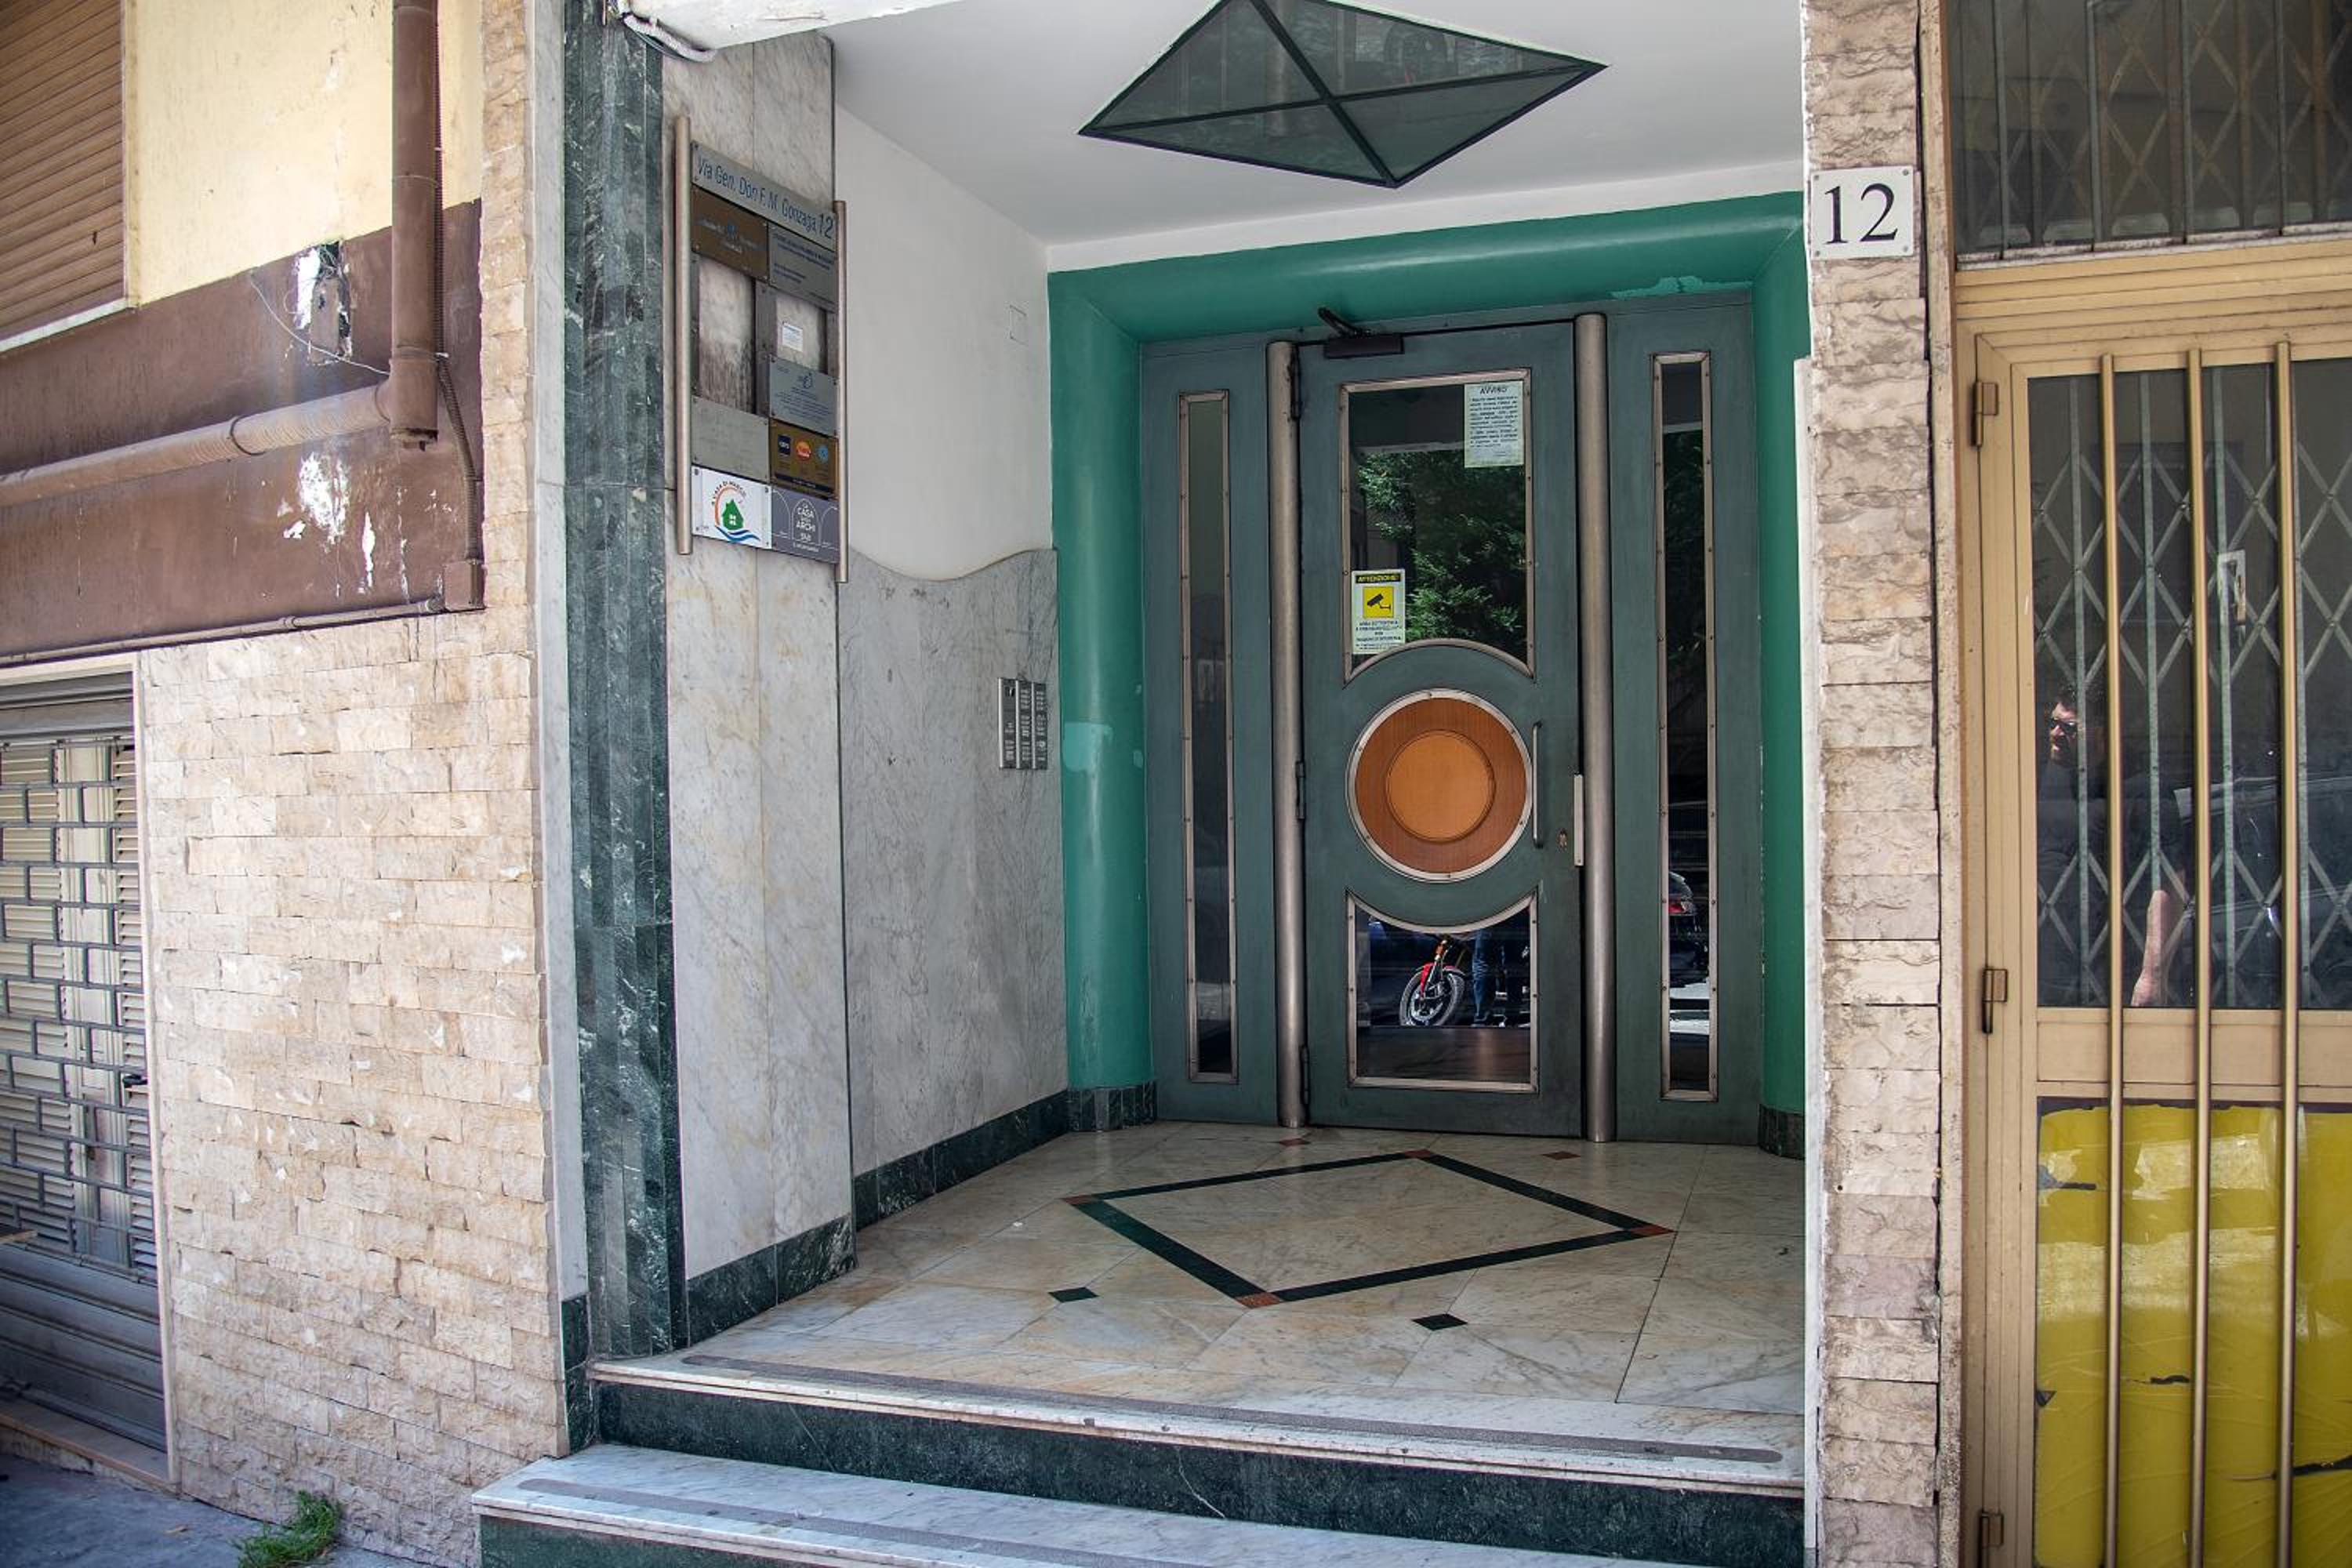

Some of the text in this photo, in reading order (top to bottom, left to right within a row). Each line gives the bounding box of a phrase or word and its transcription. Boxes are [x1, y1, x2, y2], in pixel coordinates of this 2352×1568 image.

[698, 156, 713, 180] Via
[818, 213, 833, 239] 12
[1824, 183, 1899, 245] 12
